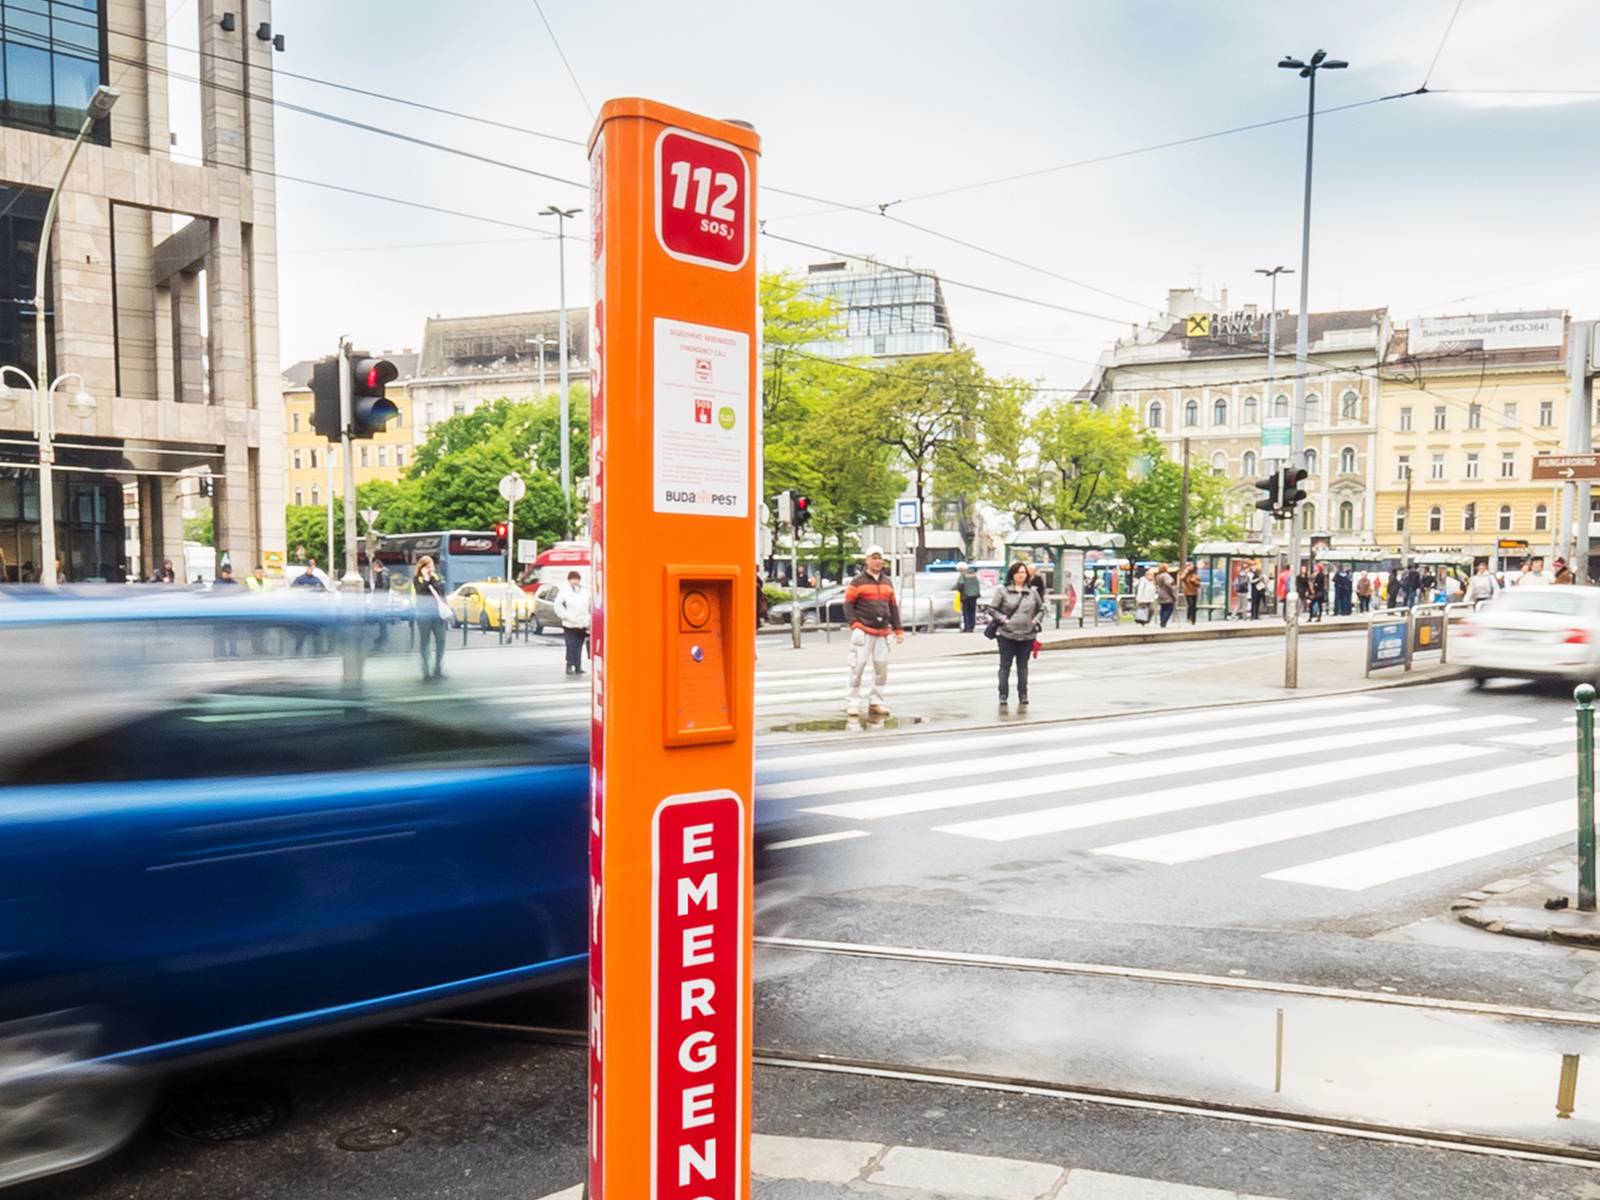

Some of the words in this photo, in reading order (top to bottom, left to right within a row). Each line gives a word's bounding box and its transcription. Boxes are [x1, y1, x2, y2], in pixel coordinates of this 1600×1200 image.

[670, 161, 738, 222] 112
[1212, 323, 1250, 335] BANK
[677, 822, 718, 1200] EMERGEN
